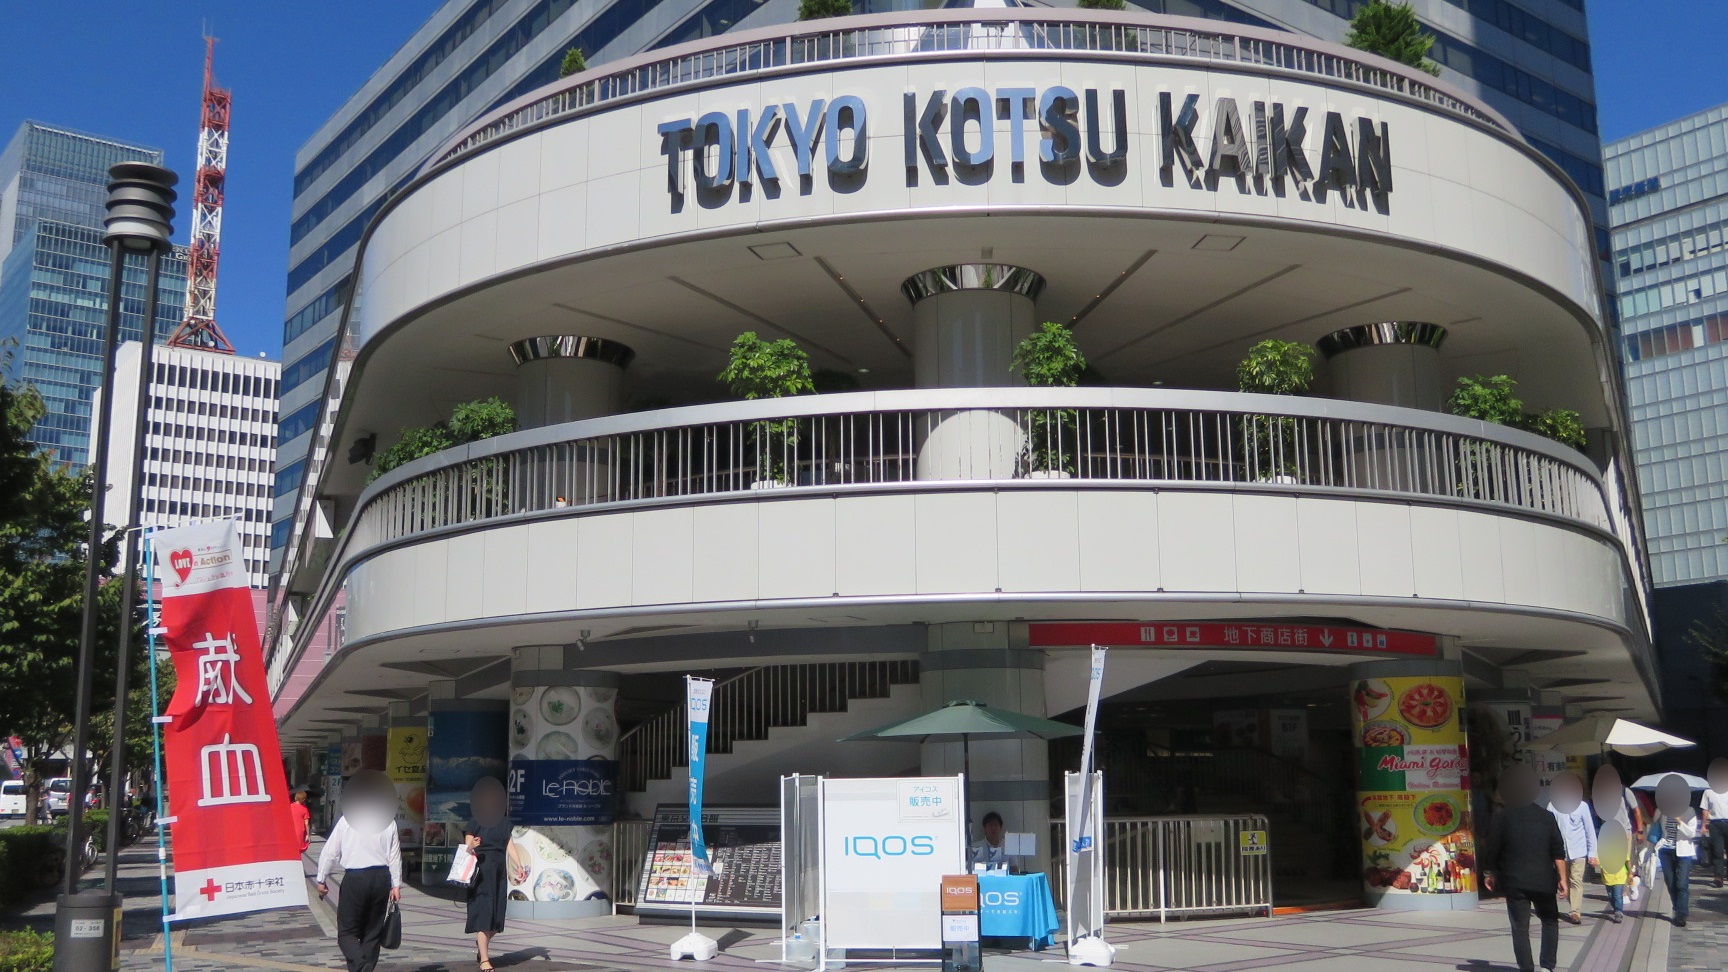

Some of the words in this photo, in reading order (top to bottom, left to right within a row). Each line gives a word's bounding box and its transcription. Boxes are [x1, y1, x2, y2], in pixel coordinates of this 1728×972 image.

[657, 94, 869, 207] TOKYO
[903, 85, 1127, 180] KOTSU
[1156, 91, 1393, 210] KAIKAN
[174, 558, 191, 569] LOVE
[201, 554, 231, 566] Action
[1224, 626, 1308, 645] 地下商店街
[193, 631, 272, 807] 献血
[1377, 754, 1426, 772] Miami
[509, 769, 525, 793] 2F
[909, 796, 942, 807] 販売中
[845, 836, 934, 860] IQOS
[225, 877, 284, 893] 日本赤十字社
[947, 886, 973, 895] IQOS
